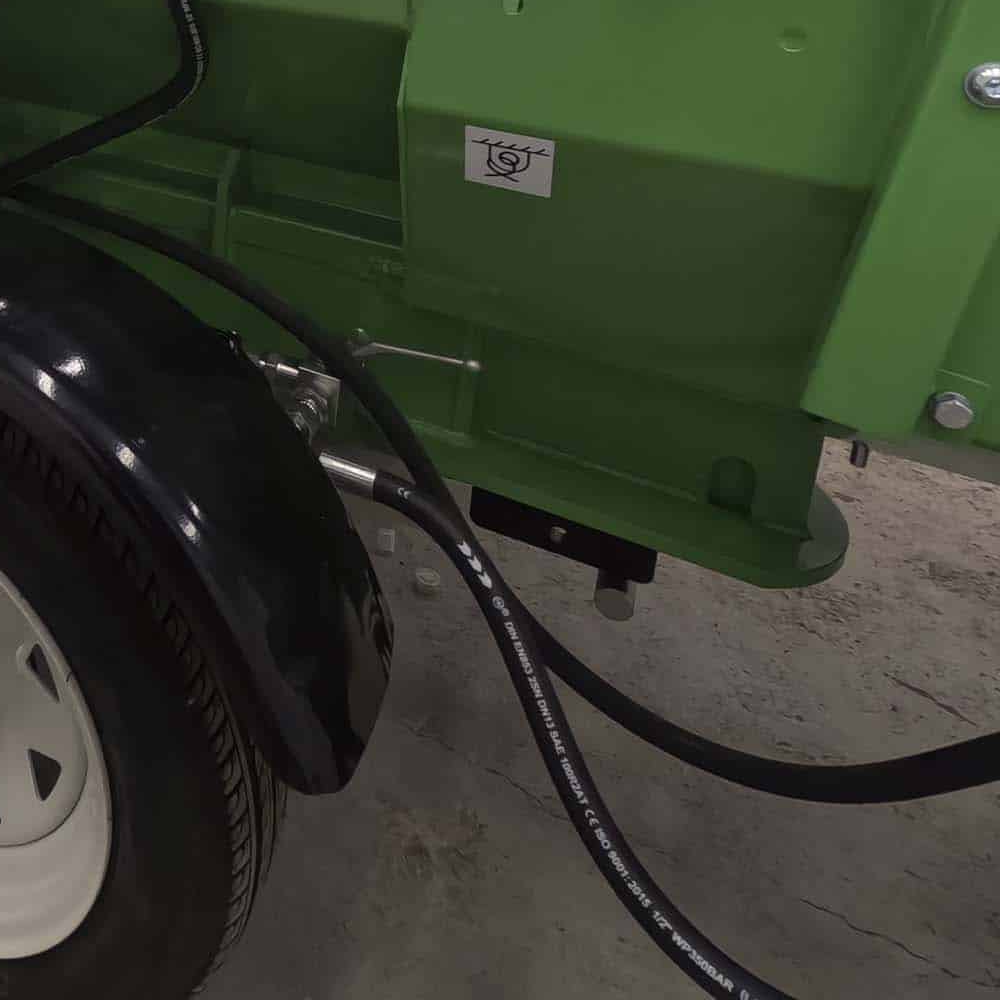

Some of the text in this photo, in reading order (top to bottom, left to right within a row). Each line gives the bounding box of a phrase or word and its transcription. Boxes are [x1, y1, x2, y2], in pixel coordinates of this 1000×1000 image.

[504, 622, 519, 640] DIN
[528, 676, 544, 698] 2SN
[549, 731, 566, 755] SAE
[560, 757, 588, 805] 100R2AT
[594, 828, 611, 849] ISO
